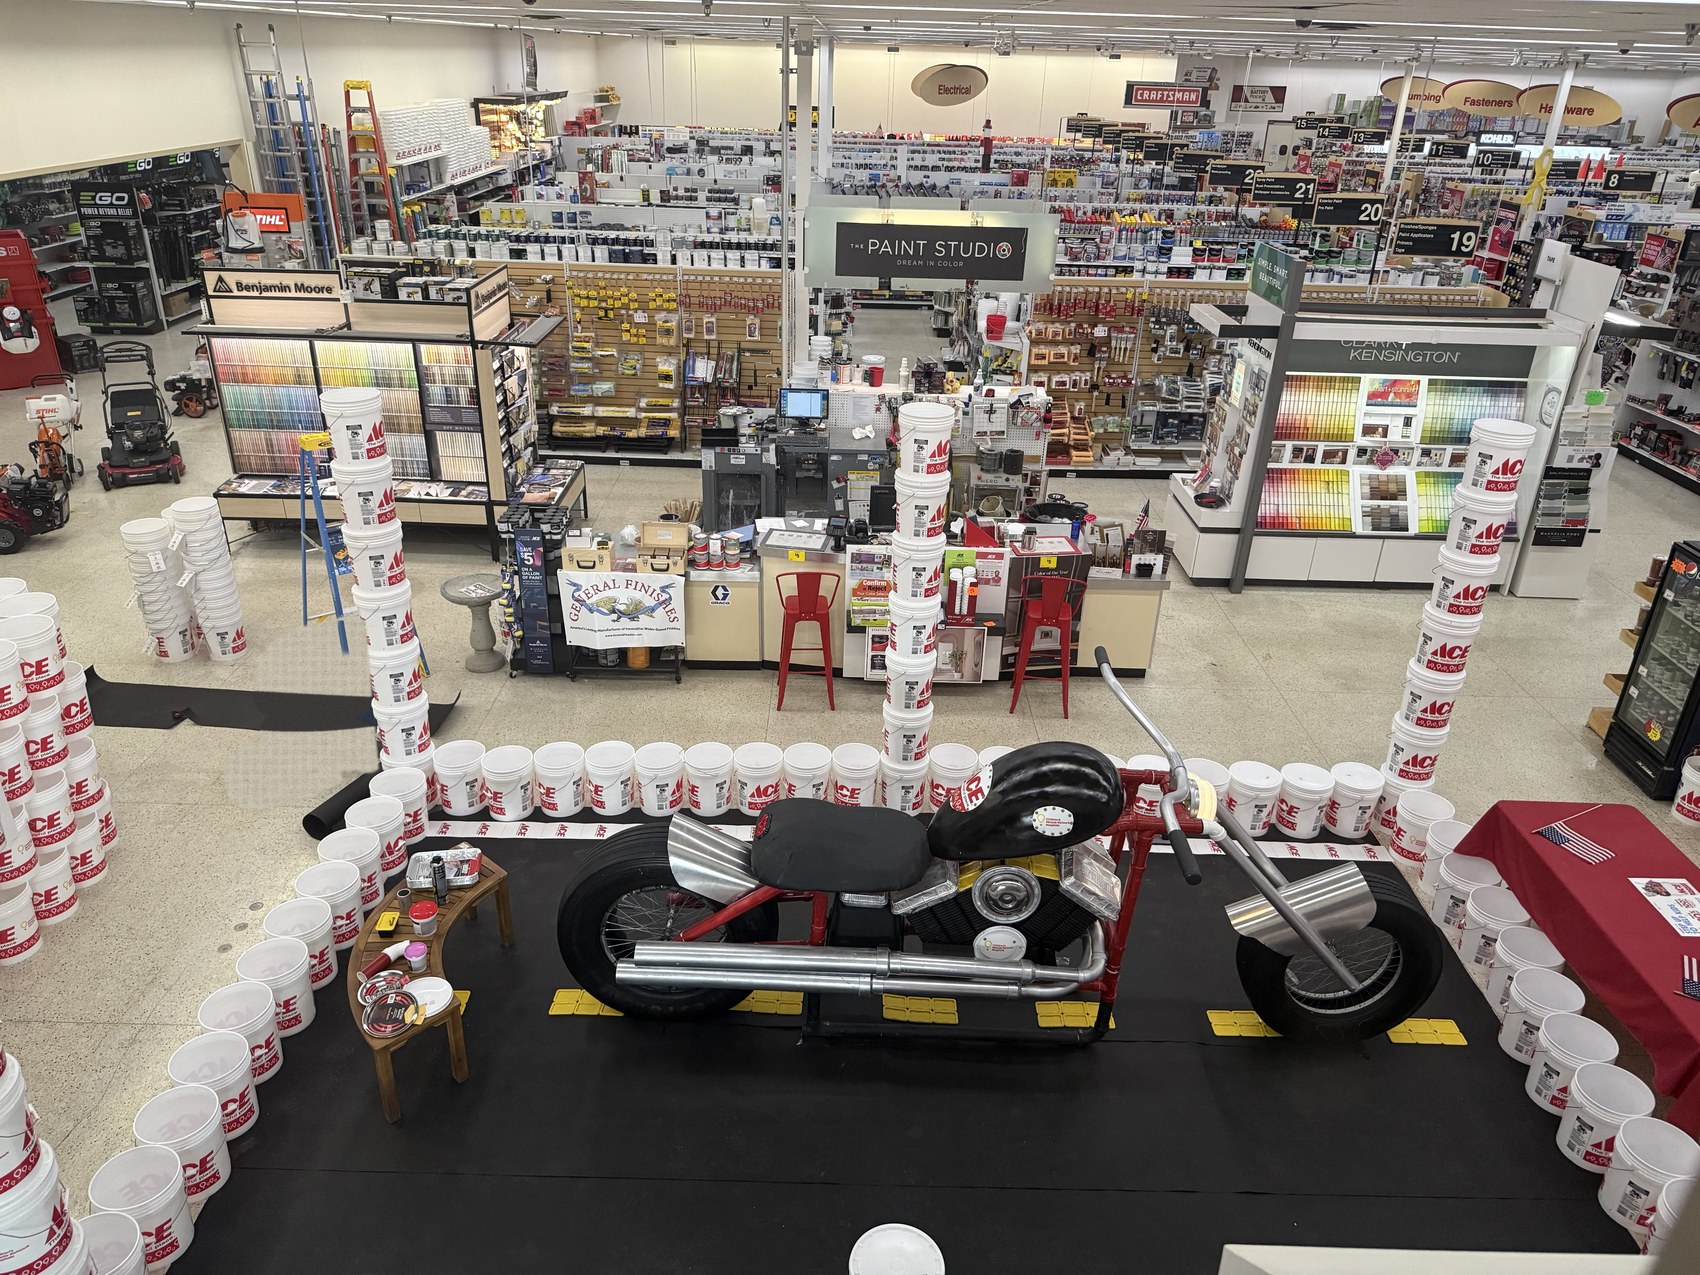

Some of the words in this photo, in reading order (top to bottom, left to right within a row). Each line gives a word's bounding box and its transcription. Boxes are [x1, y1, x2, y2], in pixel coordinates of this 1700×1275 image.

[938, 84, 971, 95] Electrical
[1137, 90, 1197, 102] CRAFTSMAN
[1407, 92, 1442, 104] umbing
[1463, 96, 1514, 107] Fasteners
[1539, 103, 1595, 116] Haware
[1296, 119, 1306, 128] 15
[1318, 127, 1329, 136] 14
[1353, 133, 1364, 142] 13
[1480, 134, 1514, 144] KOHLER
[1431, 144, 1442, 155] 11
[127, 158, 152, 171] EGO
[169, 152, 191, 165] EGO
[1478, 153, 1492, 165] 10
[1608, 174, 1619, 187] 8
[1294, 182, 1315, 198] 21
[79, 192, 128, 205] EGO
[80, 207, 98, 215] POWER
[99, 207, 117, 216] BEYOND
[118, 208, 133, 216] BELIEF
[1358, 203, 1382, 221] 20
[256, 214, 285, 225] TIHL
[868, 239, 928, 257] PAINT
[934, 241, 1013, 259] STUDIO
[1450, 231, 1477, 252] 19
[896, 259, 924, 267] DREAM
[1547, 255, 1555, 264] TAPE
[235, 280, 292, 296] Benjamin
[294, 282, 333, 295] Moore
[1247, 338, 1272, 361] KENSINGTON
[1349, 349, 1458, 363] KENSINGTON
[35, 407, 59, 415] STIHL
[569, 579, 621, 622] GENERAL
[625, 579, 680, 624] FINISHES
[1430, 642, 1472, 660] ACE
[20, 657, 50, 679] CE
[24, 734, 55, 757] CE
[1402, 753, 1440, 769] ACE
[69, 777, 88, 798] CE
[749, 778, 781, 799] ACE
[966, 775, 985, 804] CE
[1134, 796, 1160, 815] CE
[1277, 798, 1301, 818] CE
[28, 811, 61, 834] CE
[404, 806, 423, 827] CE
[439, 822, 452, 836] ACE
[479, 822, 490, 836] ACE
[519, 823, 531, 837] ACE
[558, 824, 569, 838] ACE
[597, 824, 608, 838] ACE
[1211, 840, 1223, 854] ACE
[1289, 844, 1301, 858] ACE
[1328, 845, 1341, 860] ACE
[1366, 845, 1379, 860] ACE
[70, 849, 93, 871] CE
[32, 885, 59, 907] CE
[332, 907, 357, 930] CE
[310, 945, 330, 969] CE
[275, 995, 299, 1017] CE
[250, 1032, 276, 1063] CE
[221, 1084, 251, 1118] CE
[182, 1150, 215, 1180] CE
[142, 1217, 174, 1247] CE
